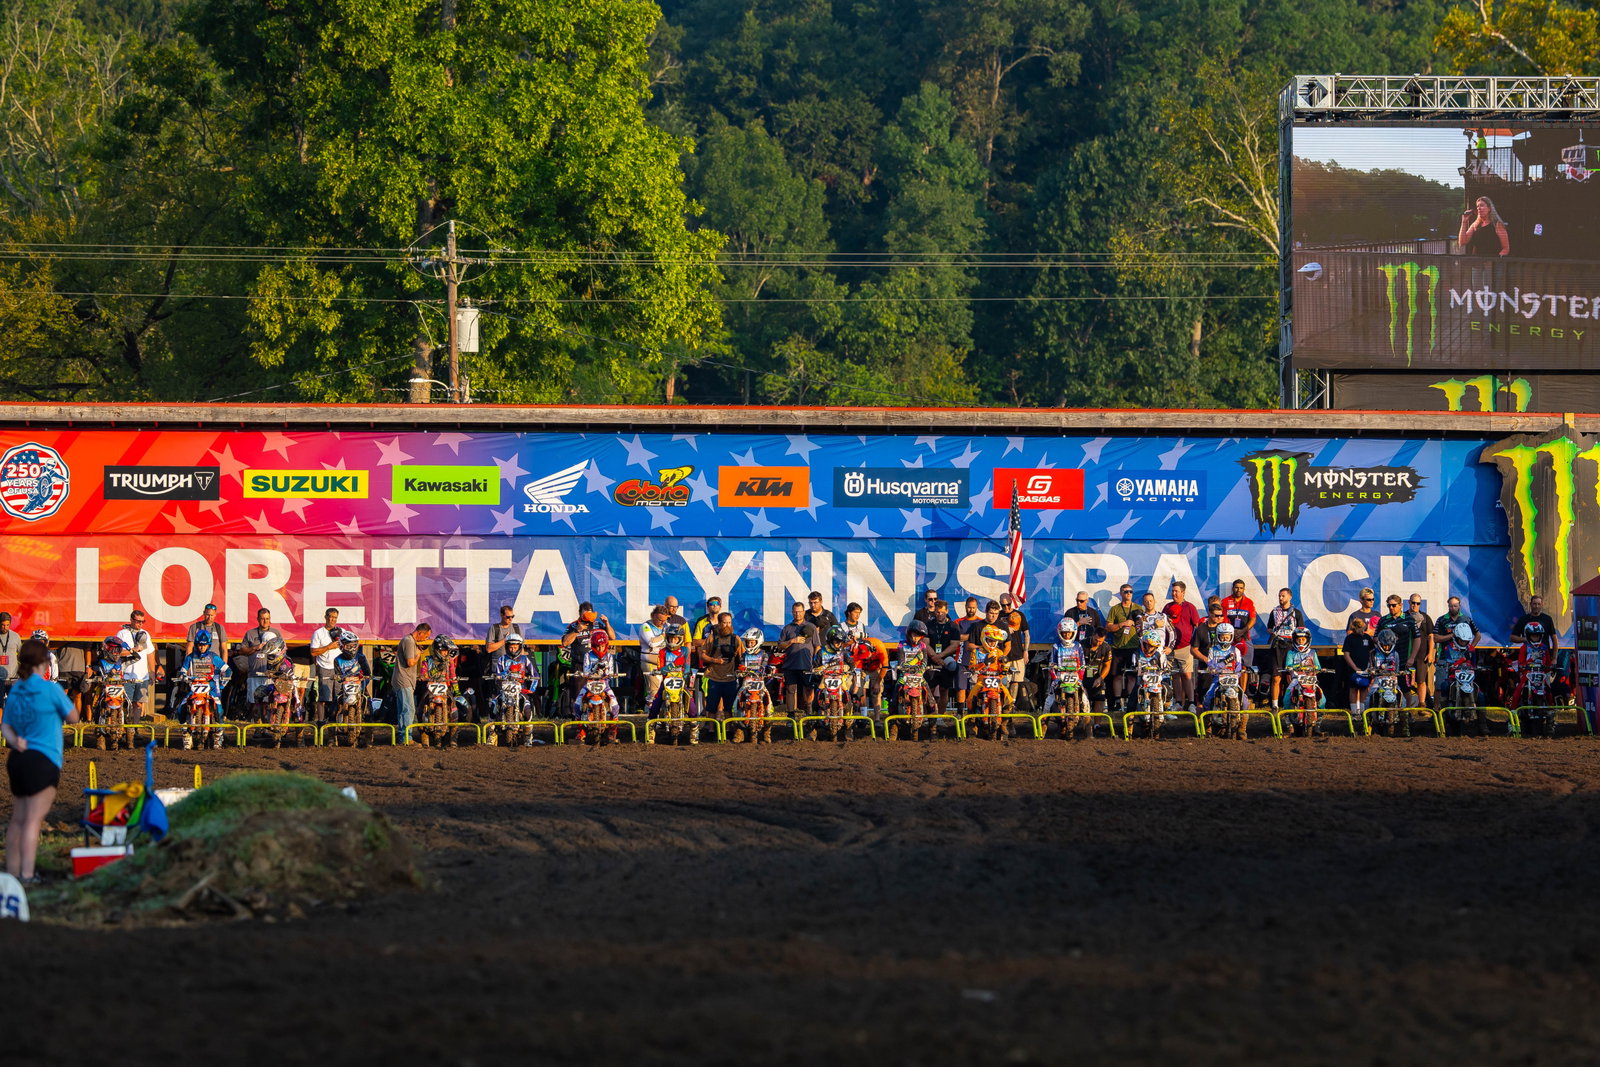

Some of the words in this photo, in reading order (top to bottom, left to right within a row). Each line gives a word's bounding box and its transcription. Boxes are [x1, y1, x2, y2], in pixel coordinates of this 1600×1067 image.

[1470, 321, 1585, 340] ENERGY
[7, 464, 41, 478] 250
[7, 479, 39, 487] YEARS
[109, 473, 193, 493] TRIUMPH
[250, 475, 359, 492] SUZUKI
[404, 478, 488, 492] Kawasaki
[1304, 469, 1413, 489] MONSTER
[614, 479, 690, 507] Cobra
[734, 477, 793, 496] KTM
[866, 479, 960, 496] Husqvarna
[1135, 479, 1199, 496] YAMAHA
[1017, 495, 1061, 503] GASGAS
[523, 503, 590, 513] HONDA
[76, 547, 579, 624] LORETTA
[626, 550, 1012, 627] LYNN'S
[1063, 553, 1450, 632] RANCH
[193, 685, 209, 693] 77
[430, 685, 446, 694] 72
[666, 680, 683, 690] 43
[827, 680, 839, 688] 14
[984, 678, 999, 688] 96
[107, 688, 122, 696] 27
